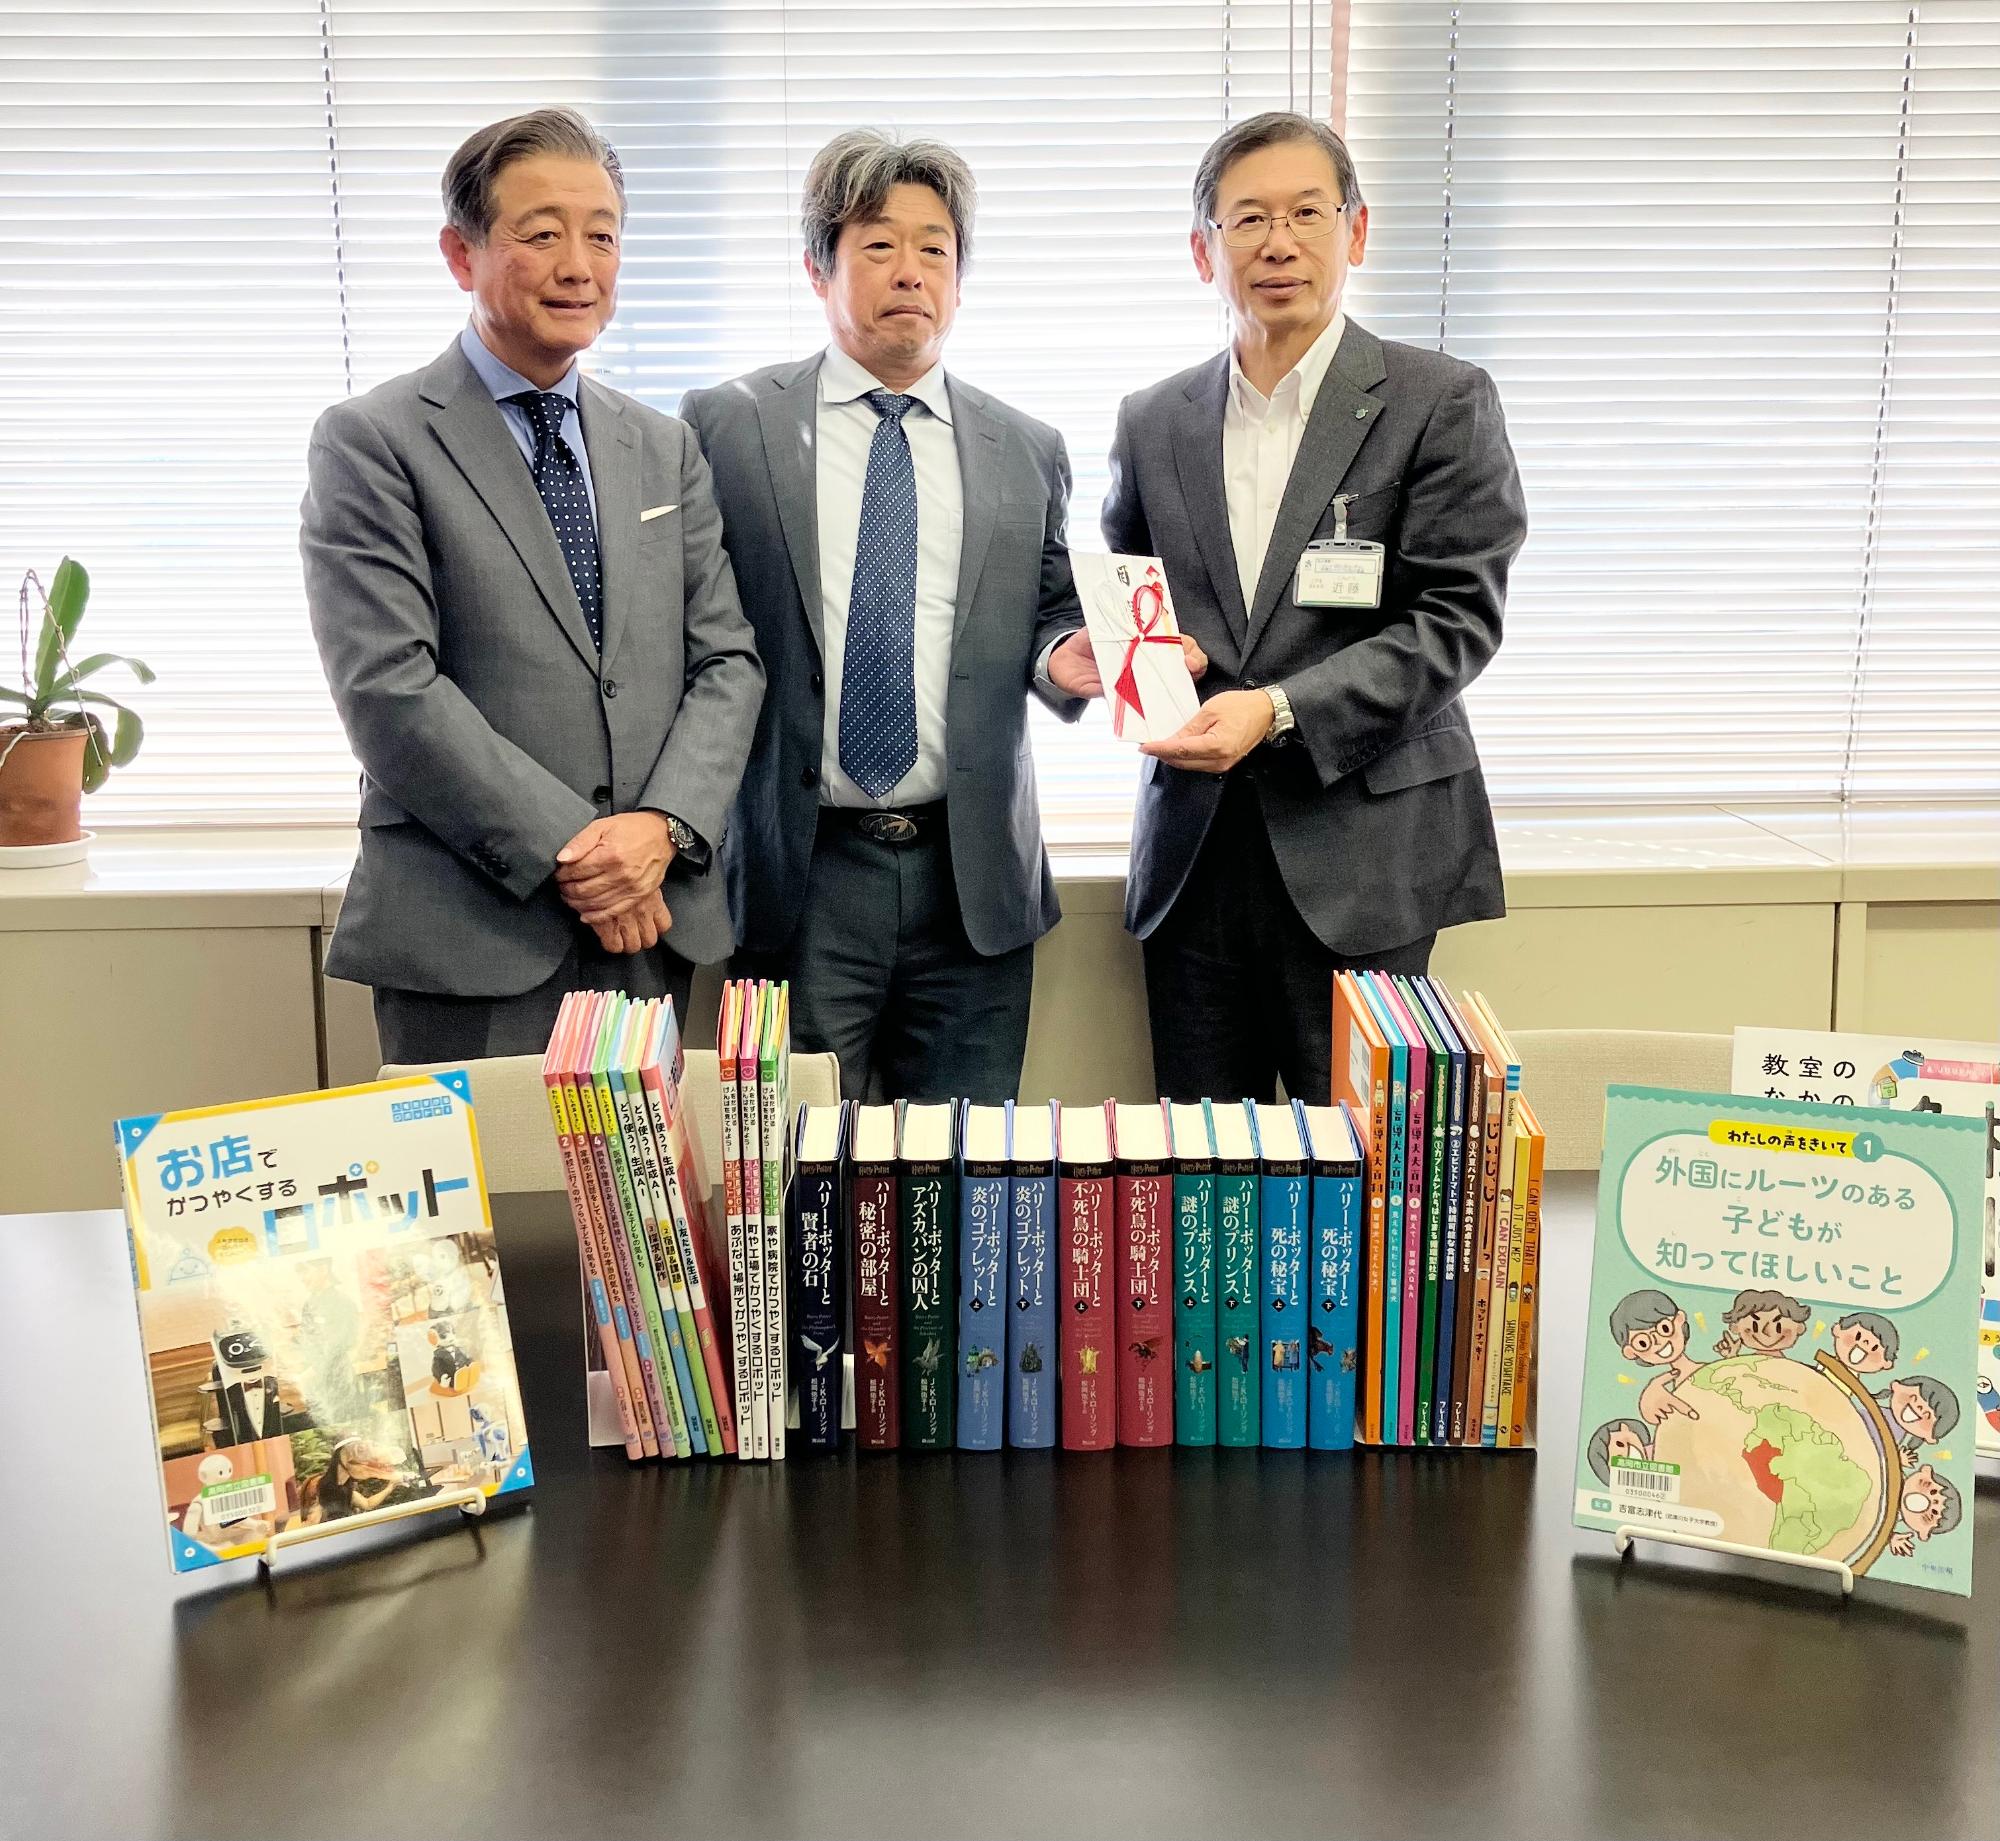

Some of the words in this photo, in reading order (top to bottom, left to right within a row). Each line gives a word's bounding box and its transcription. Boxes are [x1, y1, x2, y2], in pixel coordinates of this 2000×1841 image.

[1762, 1053, 1857, 1079] 教室の
[156, 1134, 278, 1192] お店で
[561, 1137, 570, 1147] 2
[578, 1135, 586, 1145] 3
[594, 1136, 602, 1145] 4
[610, 1137, 618, 1146] 5
[1728, 1130, 1847, 1154] わたしの声をきいて
[1864, 1139, 1872, 1155] 1
[167, 1179, 297, 1217] かつやくする
[262, 1160, 469, 1257] ロボット
[1528, 1187, 1539, 1206] CAN
[1655, 1155, 1916, 1210] 外国にルーツのある
[801, 1212, 818, 1287] 賢者の石
[817, 1181, 833, 1305] ハリー・ポッターと
[858, 1202, 877, 1297] 秘密の部屋
[876, 1182, 890, 1306] ハリー・ポッターと
[911, 1186, 929, 1311] アズカバンの囚人
[927, 1180, 942, 1305] ハリー・ポッターと
[971, 1186, 988, 1297] 炎のゴブレット
[986, 1182, 1002, 1307] ハリー・ポッターと
[1015, 1187, 1032, 1297] 炎のゴブレット
[1032, 1181, 1046, 1306] ハリー・ポッターと
[1072, 1183, 1090, 1298] 不死鳥の騎士団
[1088, 1183, 1103, 1307] ハリー・ポッターと
[1129, 1180, 1147, 1295] 不死鳥の騎士団
[1146, 1180, 1161, 1305] ハリー・ポッターと
[1181, 1195, 1198, 1295] 謎のプリンス
[1197, 1179, 1212, 1304] ハリー・ポッターと
[1222, 1196, 1239, 1294] 謎のプリンス
[1239, 1180, 1254, 1305] ハリー・ポッターと
[1287, 1181, 1302, 1306] ハリー・ポッターと
[1339, 1182, 1354, 1307] ハリー・ポッターと
[1498, 1217, 1509, 1242] CAN
[1512, 1223, 1522, 1242] JUST
[1526, 1211, 1538, 1234] OPEN
[1722, 1204, 1842, 1243] 子どもが
[1270, 1227, 1289, 1297] 死の秘宝
[1321, 1227, 1339, 1297] 死の秘宝
[1496, 1245, 1508, 1289] EXPLAIN
[1511, 1246, 1521, 1263] ME?
[1655, 1239, 1903, 1296] 知ってほしいこと
[730, 1224, 751, 1426] あぶない場所でかつやくするロボット
[747, 1224, 764, 1402] 町や工場でかつやくするロボット
[766, 1225, 782, 1402] 家や病院でかつやくするロボット
[973, 1301, 980, 1309] 上
[1020, 1301, 1027, 1309] 下
[1135, 1300, 1142, 1308] 下
[1187, 1299, 1194, 1307] 上
[1229, 1300, 1235, 1308] 下
[1325, 1302, 1332, 1310] 下
[1505, 1320, 1516, 1353] SHINSUKE
[1501, 1355, 1515, 1396] YOSHITAKE
[1420, 1401, 1428, 1439] フレーベル館
[1438, 1401, 1446, 1438] フレーベル館
[1453, 1401, 1462, 1438] フレーベル館
[1619, 1503, 1662, 1520] 吉富志津代
